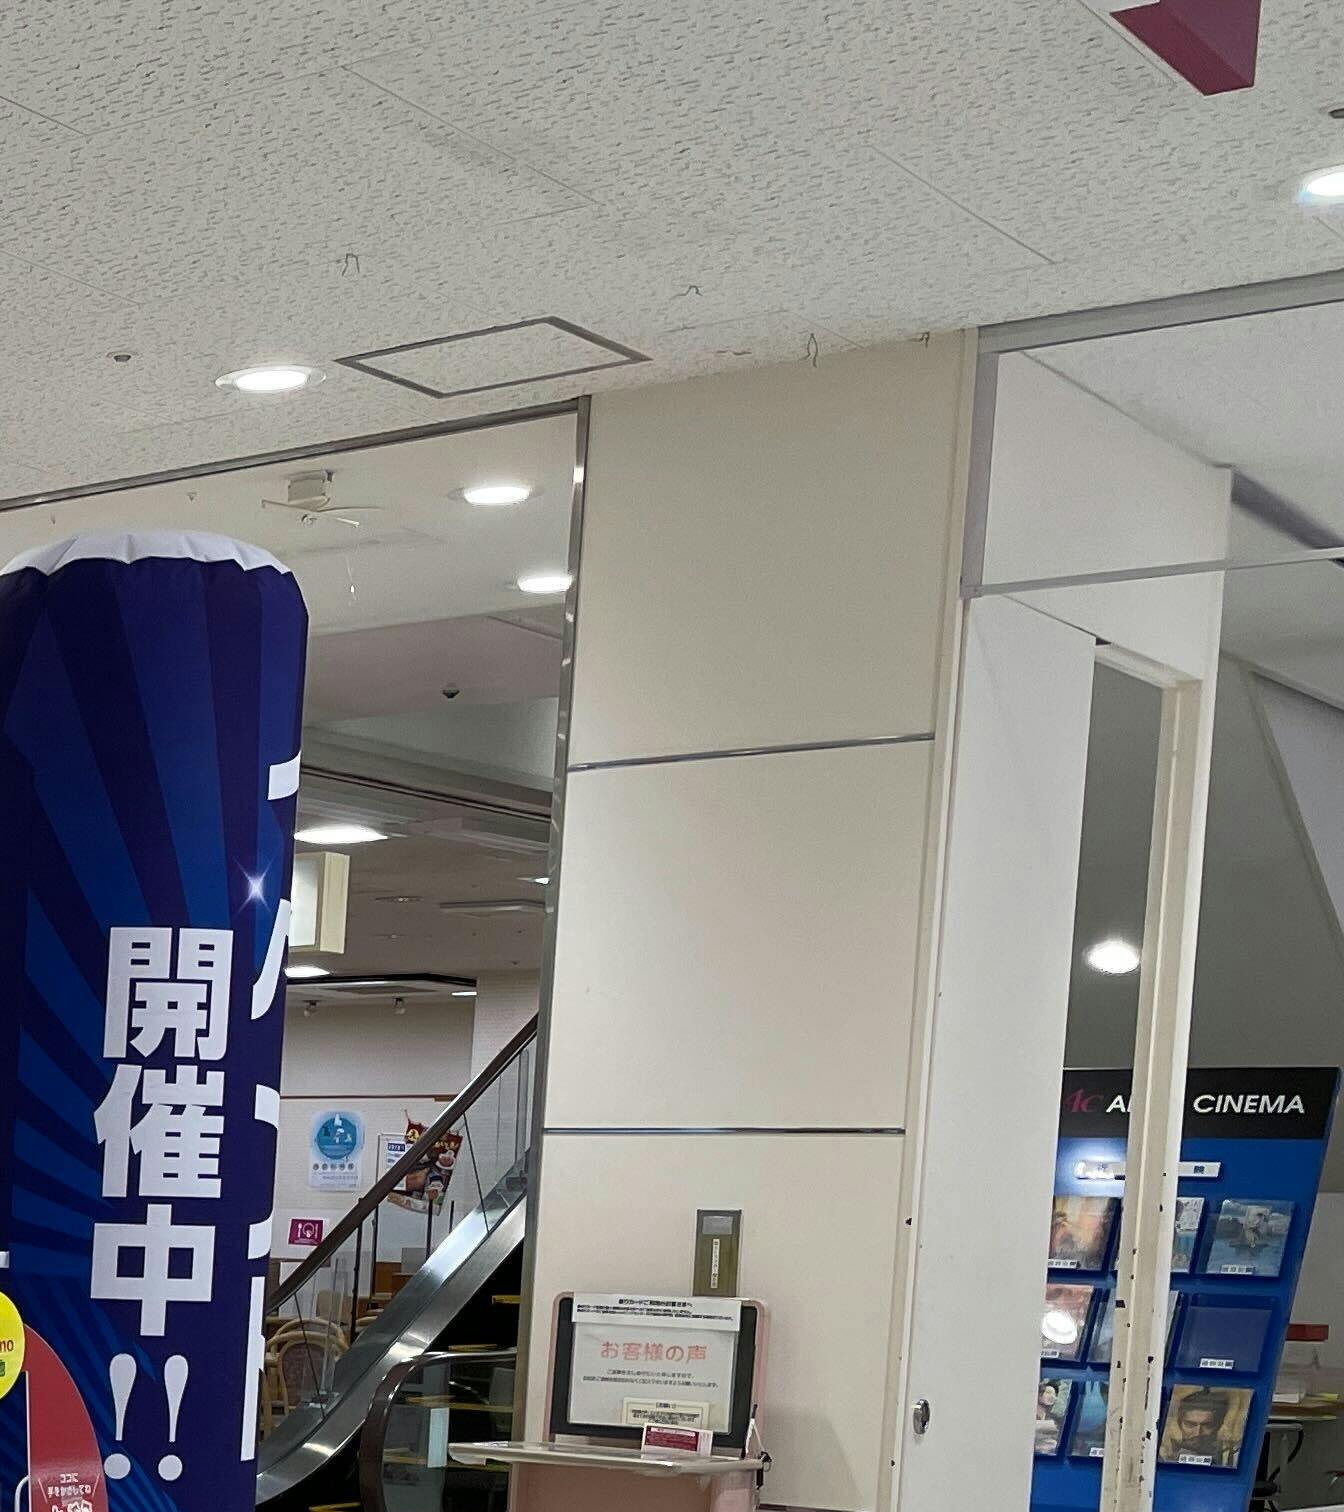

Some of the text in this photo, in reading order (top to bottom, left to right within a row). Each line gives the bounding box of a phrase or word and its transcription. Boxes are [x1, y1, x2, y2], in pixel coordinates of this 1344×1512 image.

[1192, 1094, 1306, 1114] CINEMA
[600, 1340, 708, 1364] お客様の声
